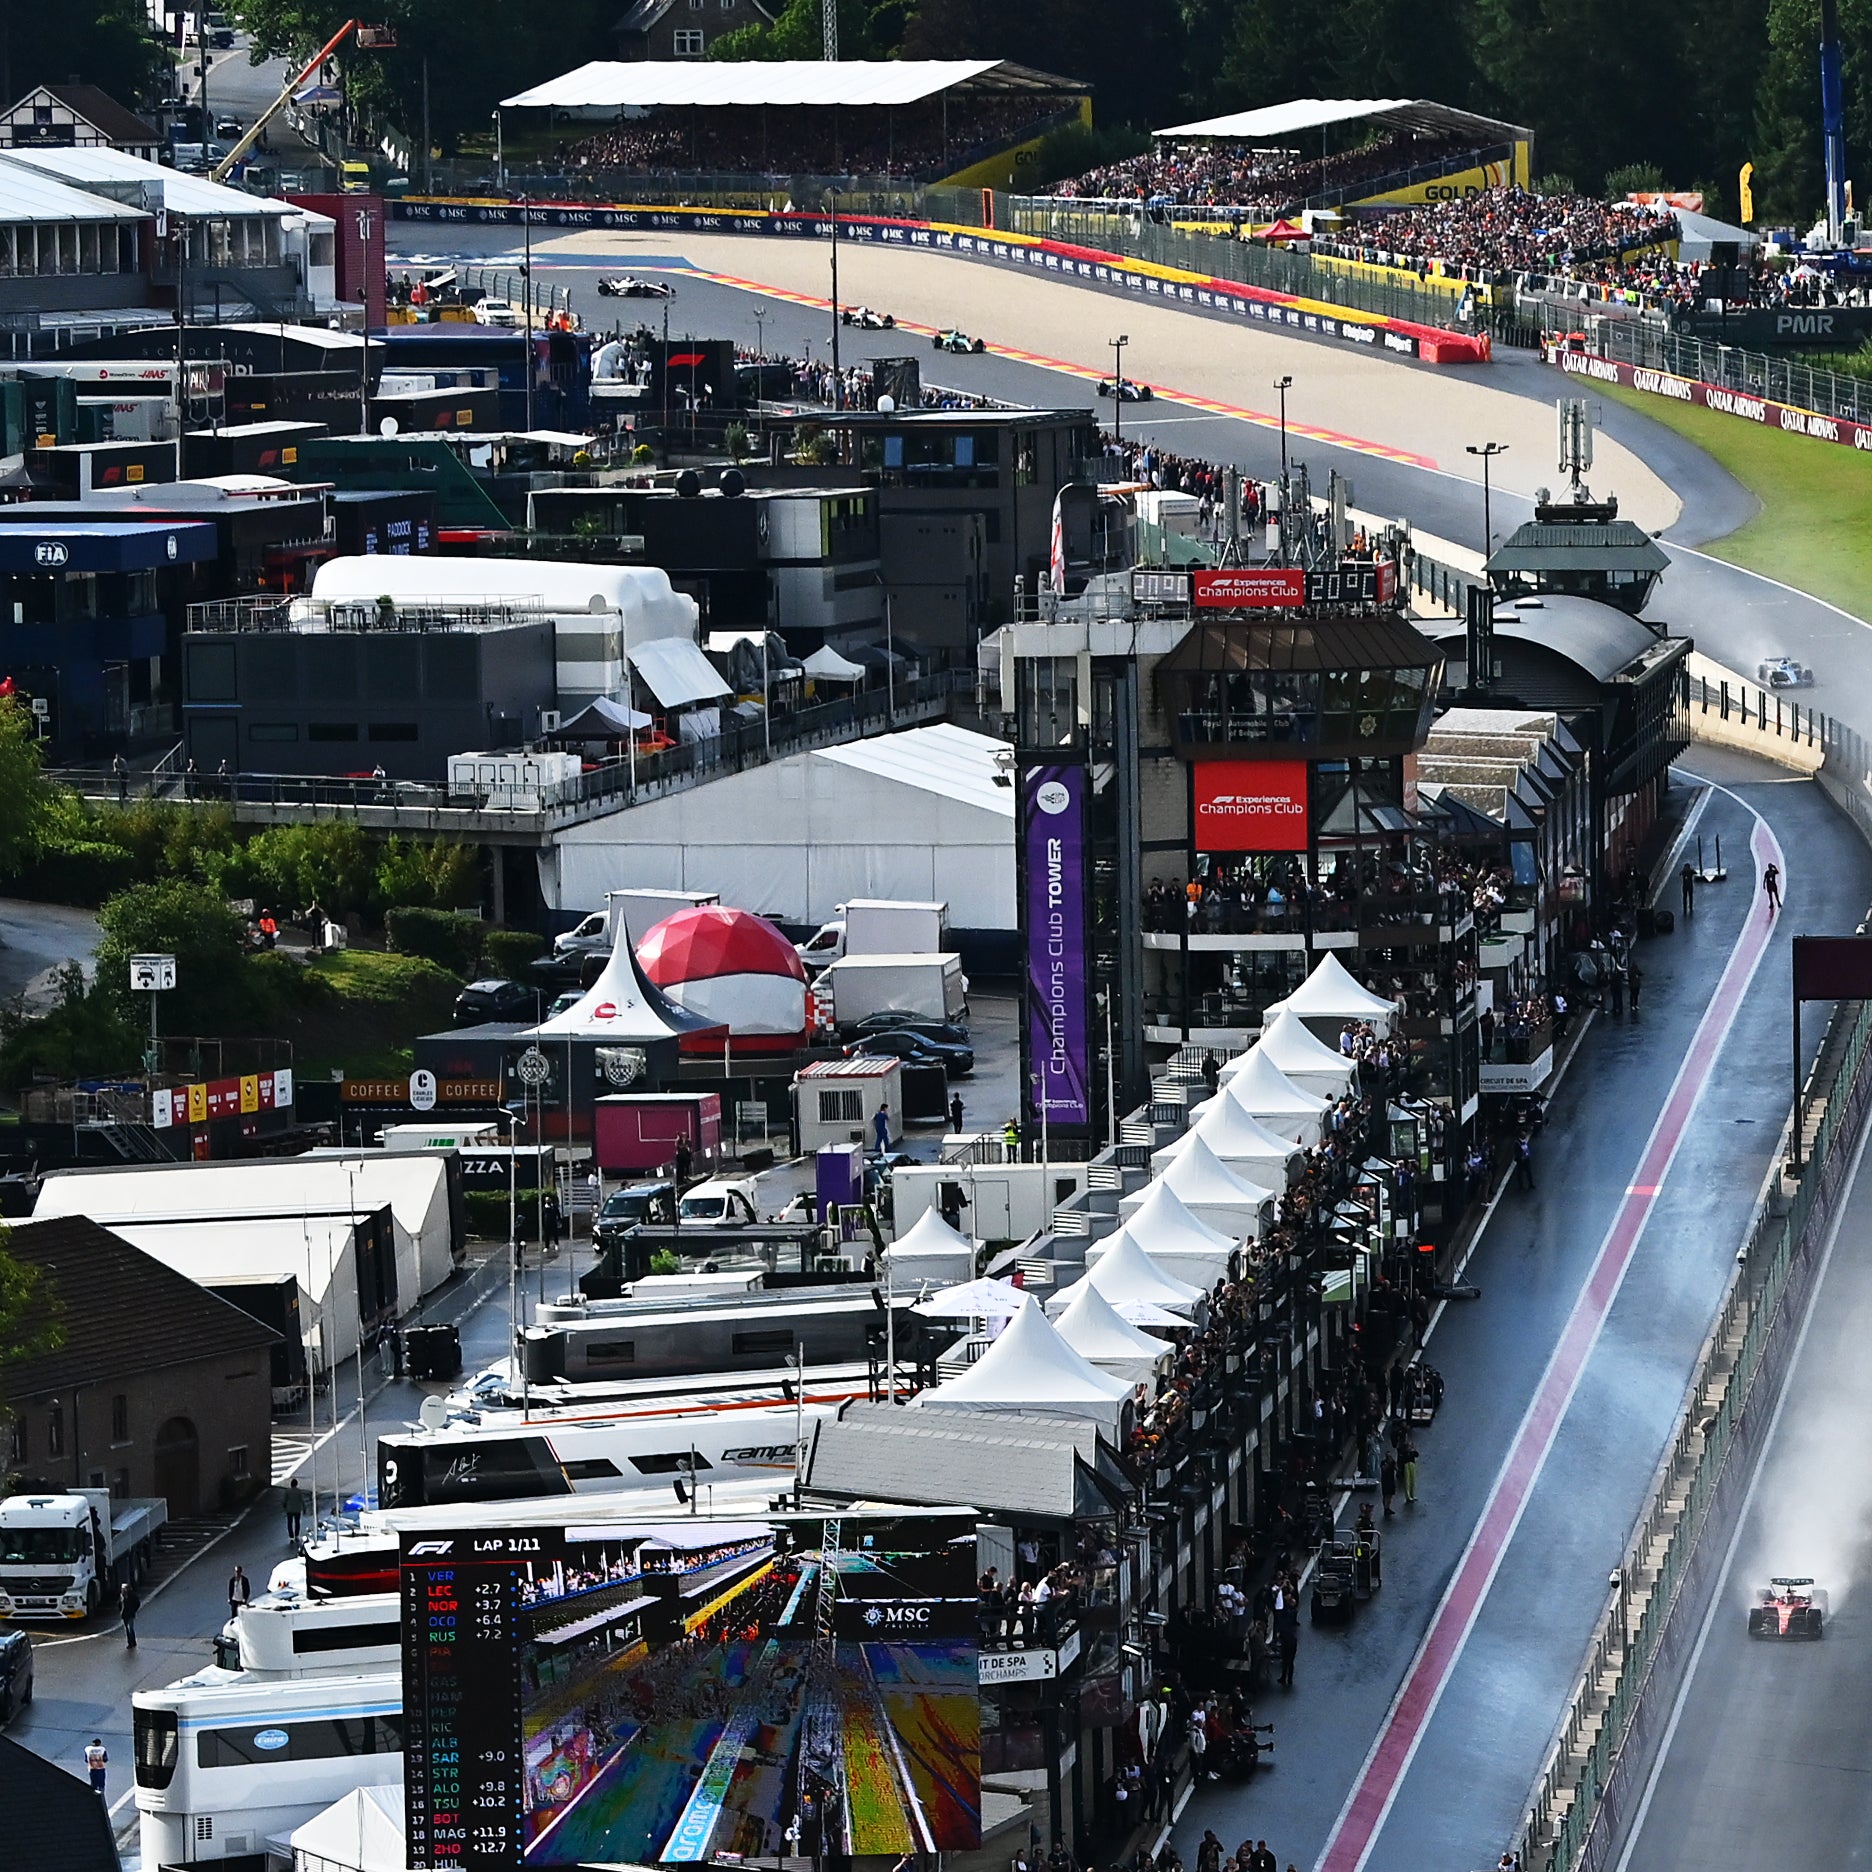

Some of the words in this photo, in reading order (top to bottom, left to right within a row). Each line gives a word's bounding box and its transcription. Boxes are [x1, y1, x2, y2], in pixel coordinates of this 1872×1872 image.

[448, 207, 467, 218] MSC
[488, 209, 507, 220] MSC
[528, 211, 547, 221] MSC
[568, 212, 592, 222] MSC
[614, 213, 638, 224] MSC
[661, 214, 680, 225] MSC
[702, 216, 721, 227] MSC
[743, 218, 761, 230] MSC
[783, 220, 802, 231] MSC
[1776, 315, 1834, 334] PMR
[1562, 352, 1587, 375] QATAR
[1587, 357, 1618, 383] AIRWAYS
[1633, 369, 1659, 392] QATAR
[1659, 375, 1692, 400] AIRWAYS
[1706, 388, 1731, 411] QATAR
[1732, 396, 1766, 422] AIRWAYS
[1780, 408, 1805, 433] QATAR
[1807, 416, 1839, 442] AIRWAYS
[1233, 578, 1287, 587] Experiences
[1198, 586, 1269, 598] Champions
[1271, 586, 1299, 596] Club
[1273, 718, 1290, 728] Club
[1236, 795, 1291, 804] Experiences
[1199, 803, 1272, 815] Champions
[1274, 802, 1304, 814] Club
[1048, 838, 1062, 909] TOWER
[1048, 912, 1063, 956] Club
[1050, 960, 1068, 1075] Champions
[350, 1084, 401, 1097] COFFEE
[445, 1083, 496, 1097] COFFEE
[474, 1539, 503, 1551] LAP
[508, 1538, 541, 1552] 1/11
[427, 1571, 455, 1581] VER
[427, 1586, 453, 1596] LEC
[475, 1584, 501, 1595] +2.7
[427, 1601, 458, 1611] NOR
[475, 1600, 501, 1610] +3.7
[428, 1616, 456, 1627] OCO
[475, 1614, 502, 1625] +6.4
[885, 1607, 931, 1624] MSC
[429, 1631, 456, 1642] RUS
[476, 1630, 502, 1640] +7.2
[990, 1656, 1003, 1668] DE
[1006, 1655, 1027, 1667] SPA
[432, 1738, 458, 1748] ALB
[432, 1752, 460, 1763] SAR
[478, 1750, 505, 1762] +9.0
[432, 1768, 459, 1778] STR
[433, 1783, 460, 1793] ALO
[479, 1781, 505, 1792] +9.8
[433, 1798, 460, 1809] TSU
[472, 1796, 506, 1807] +10.2
[433, 1813, 460, 1824] BOT
[433, 1828, 467, 1839] MAG
[472, 1827, 506, 1837] +11.9
[433, 1844, 461, 1854] ZHO
[473, 1842, 506, 1853] +12.7
